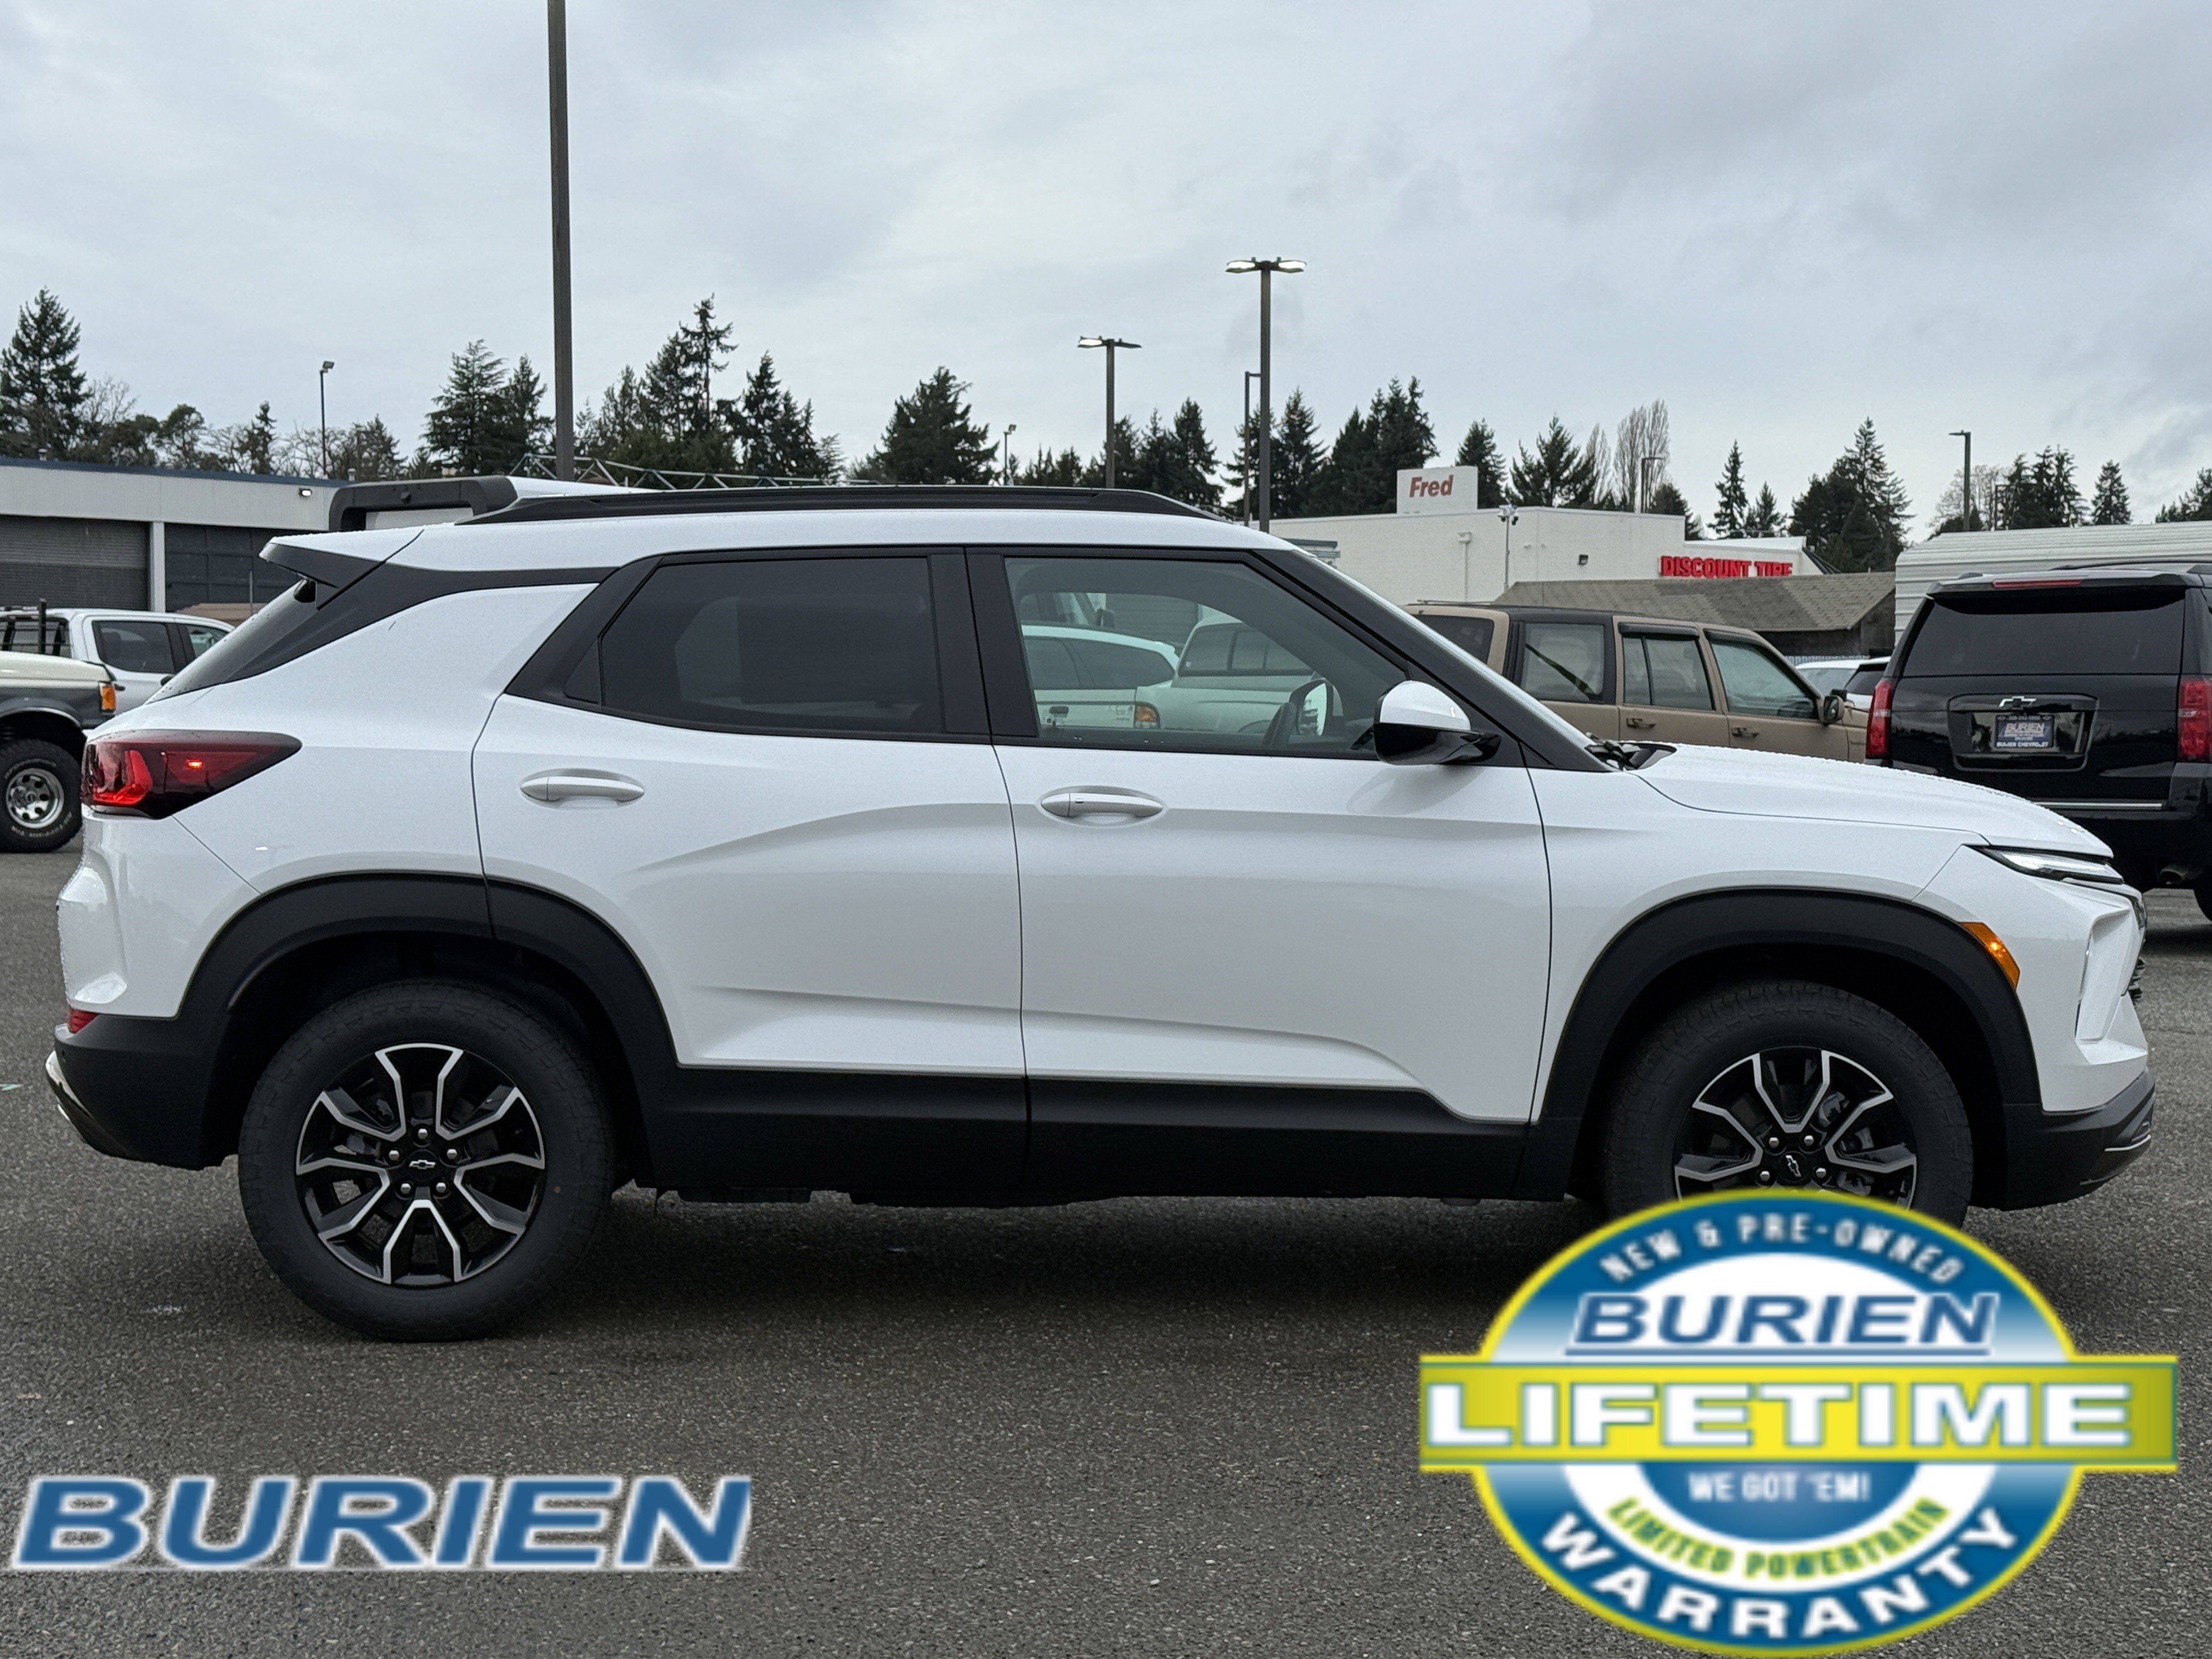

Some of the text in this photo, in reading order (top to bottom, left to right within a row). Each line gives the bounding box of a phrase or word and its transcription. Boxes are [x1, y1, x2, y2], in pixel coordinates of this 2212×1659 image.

[1409, 475, 1454, 498] Fred
[1661, 556, 1793, 578] DISCOUNT TIRE
[2005, 723, 2045, 733] BURIEN
